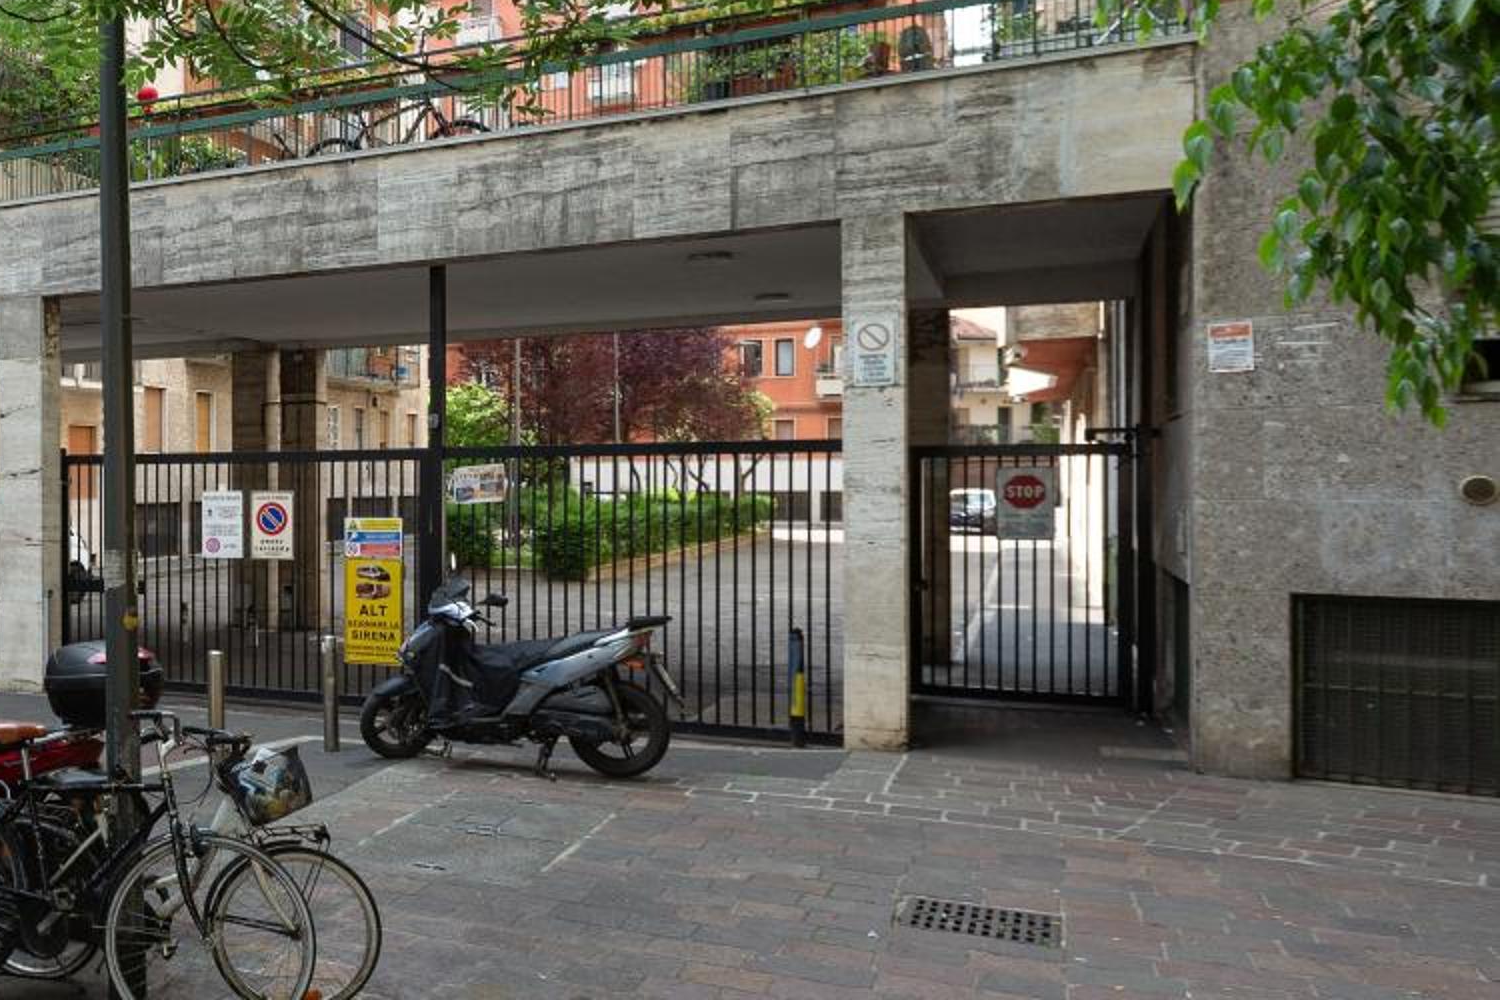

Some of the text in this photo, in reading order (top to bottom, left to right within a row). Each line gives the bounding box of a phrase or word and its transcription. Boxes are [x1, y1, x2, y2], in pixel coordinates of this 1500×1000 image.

[1006, 485, 1043, 499] STOP
[359, 604, 389, 617] ALT
[351, 630, 397, 641] SIRENA
